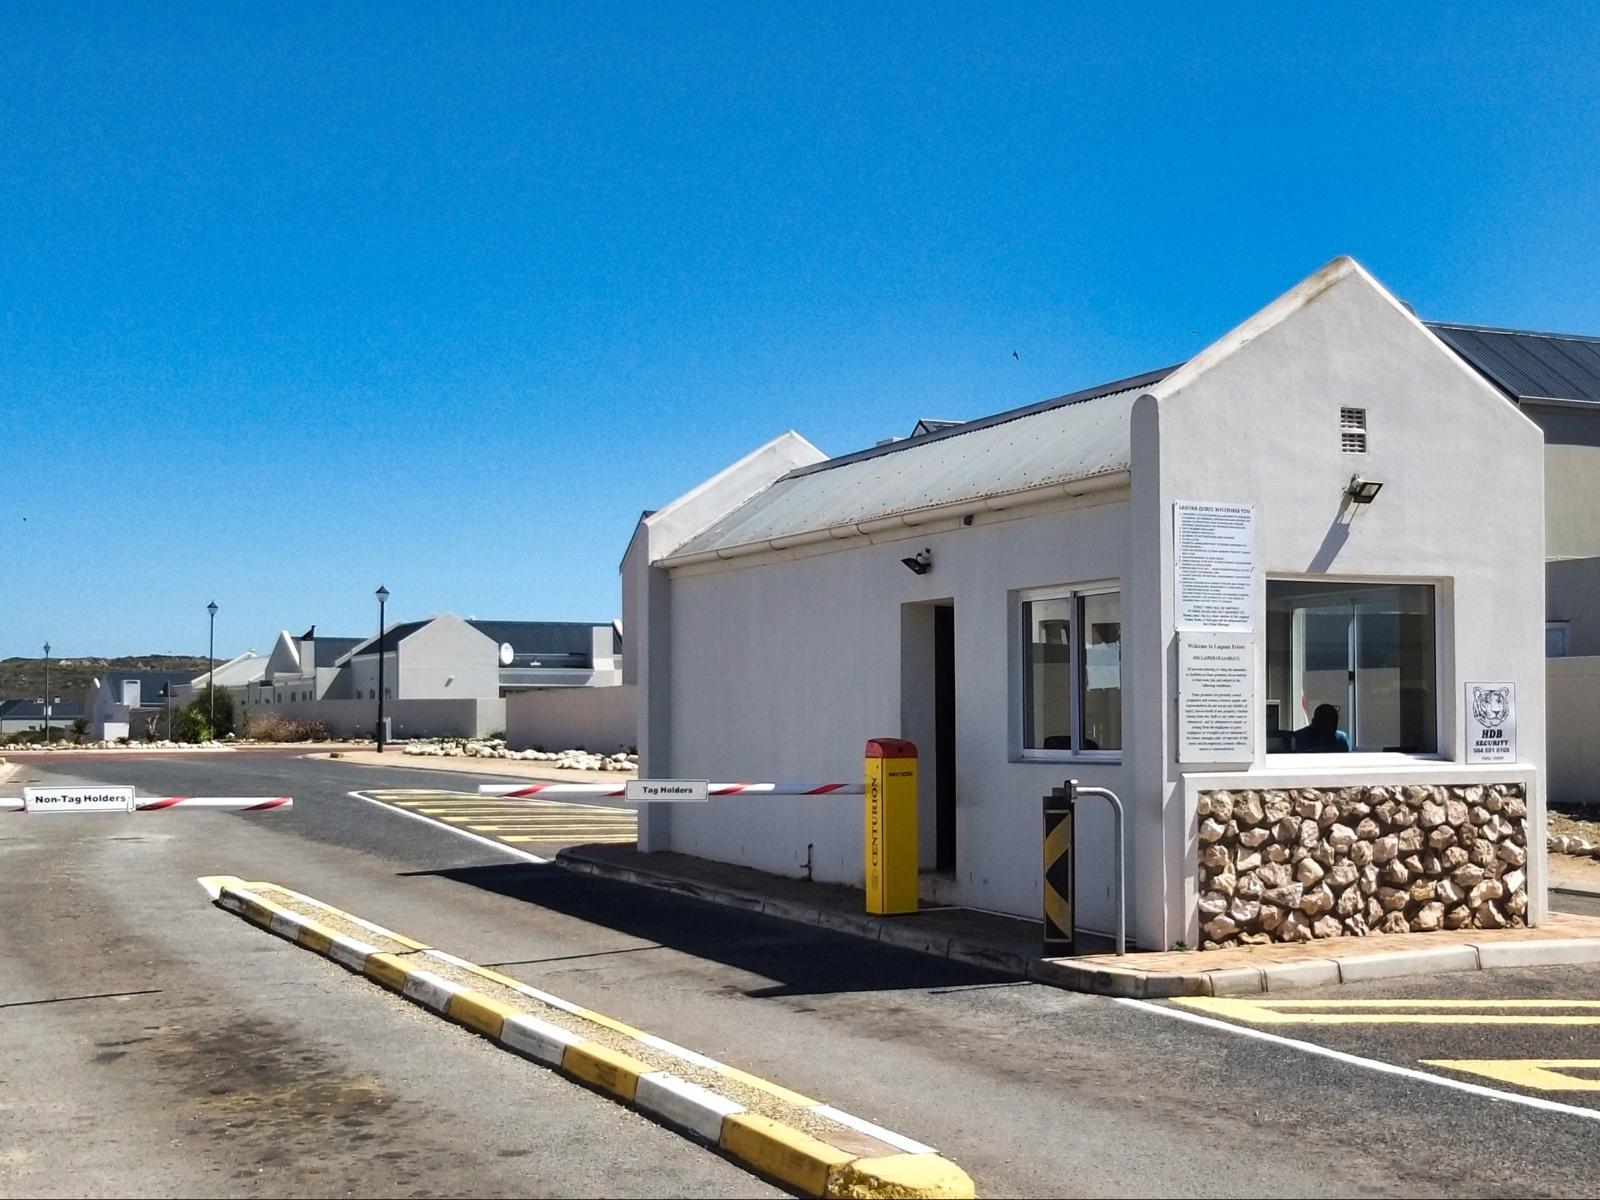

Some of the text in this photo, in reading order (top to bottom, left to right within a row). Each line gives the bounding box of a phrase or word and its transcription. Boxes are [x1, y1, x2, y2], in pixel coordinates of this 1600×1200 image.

[1481, 729, 1503, 739] HDB
[642, 786, 693, 795] Tag Holders
[35, 794, 126, 804] Non-Tag Holders
[871, 777, 879, 867] CENTURION
